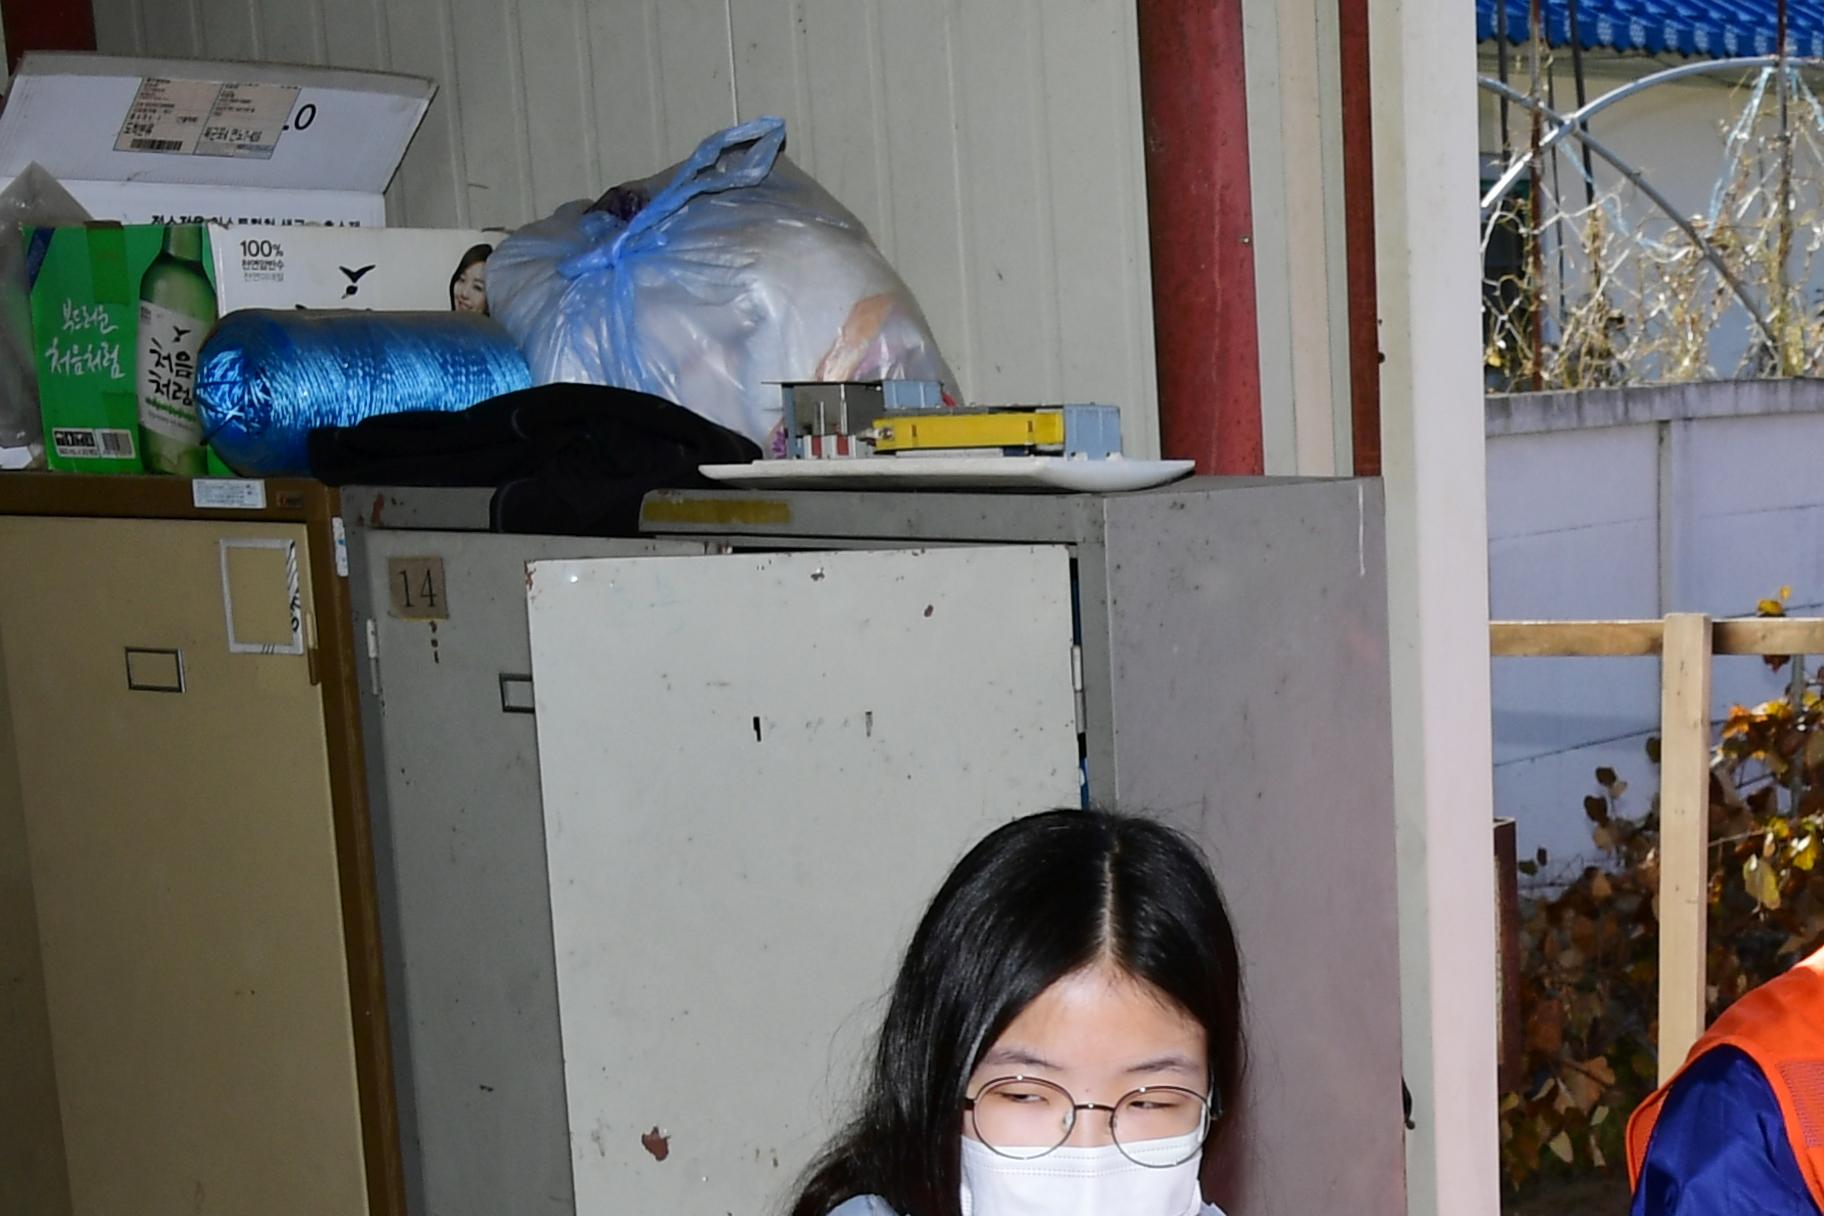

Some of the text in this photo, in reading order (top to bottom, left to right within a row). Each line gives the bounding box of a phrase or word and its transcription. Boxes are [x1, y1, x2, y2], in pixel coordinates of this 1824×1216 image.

[240, 239, 284, 257] 100%
[45, 337, 126, 380] 처음처럼
[149, 337, 194, 379] 처음
[147, 369, 194, 407] 처럼
[396, 569, 437, 607] 14
